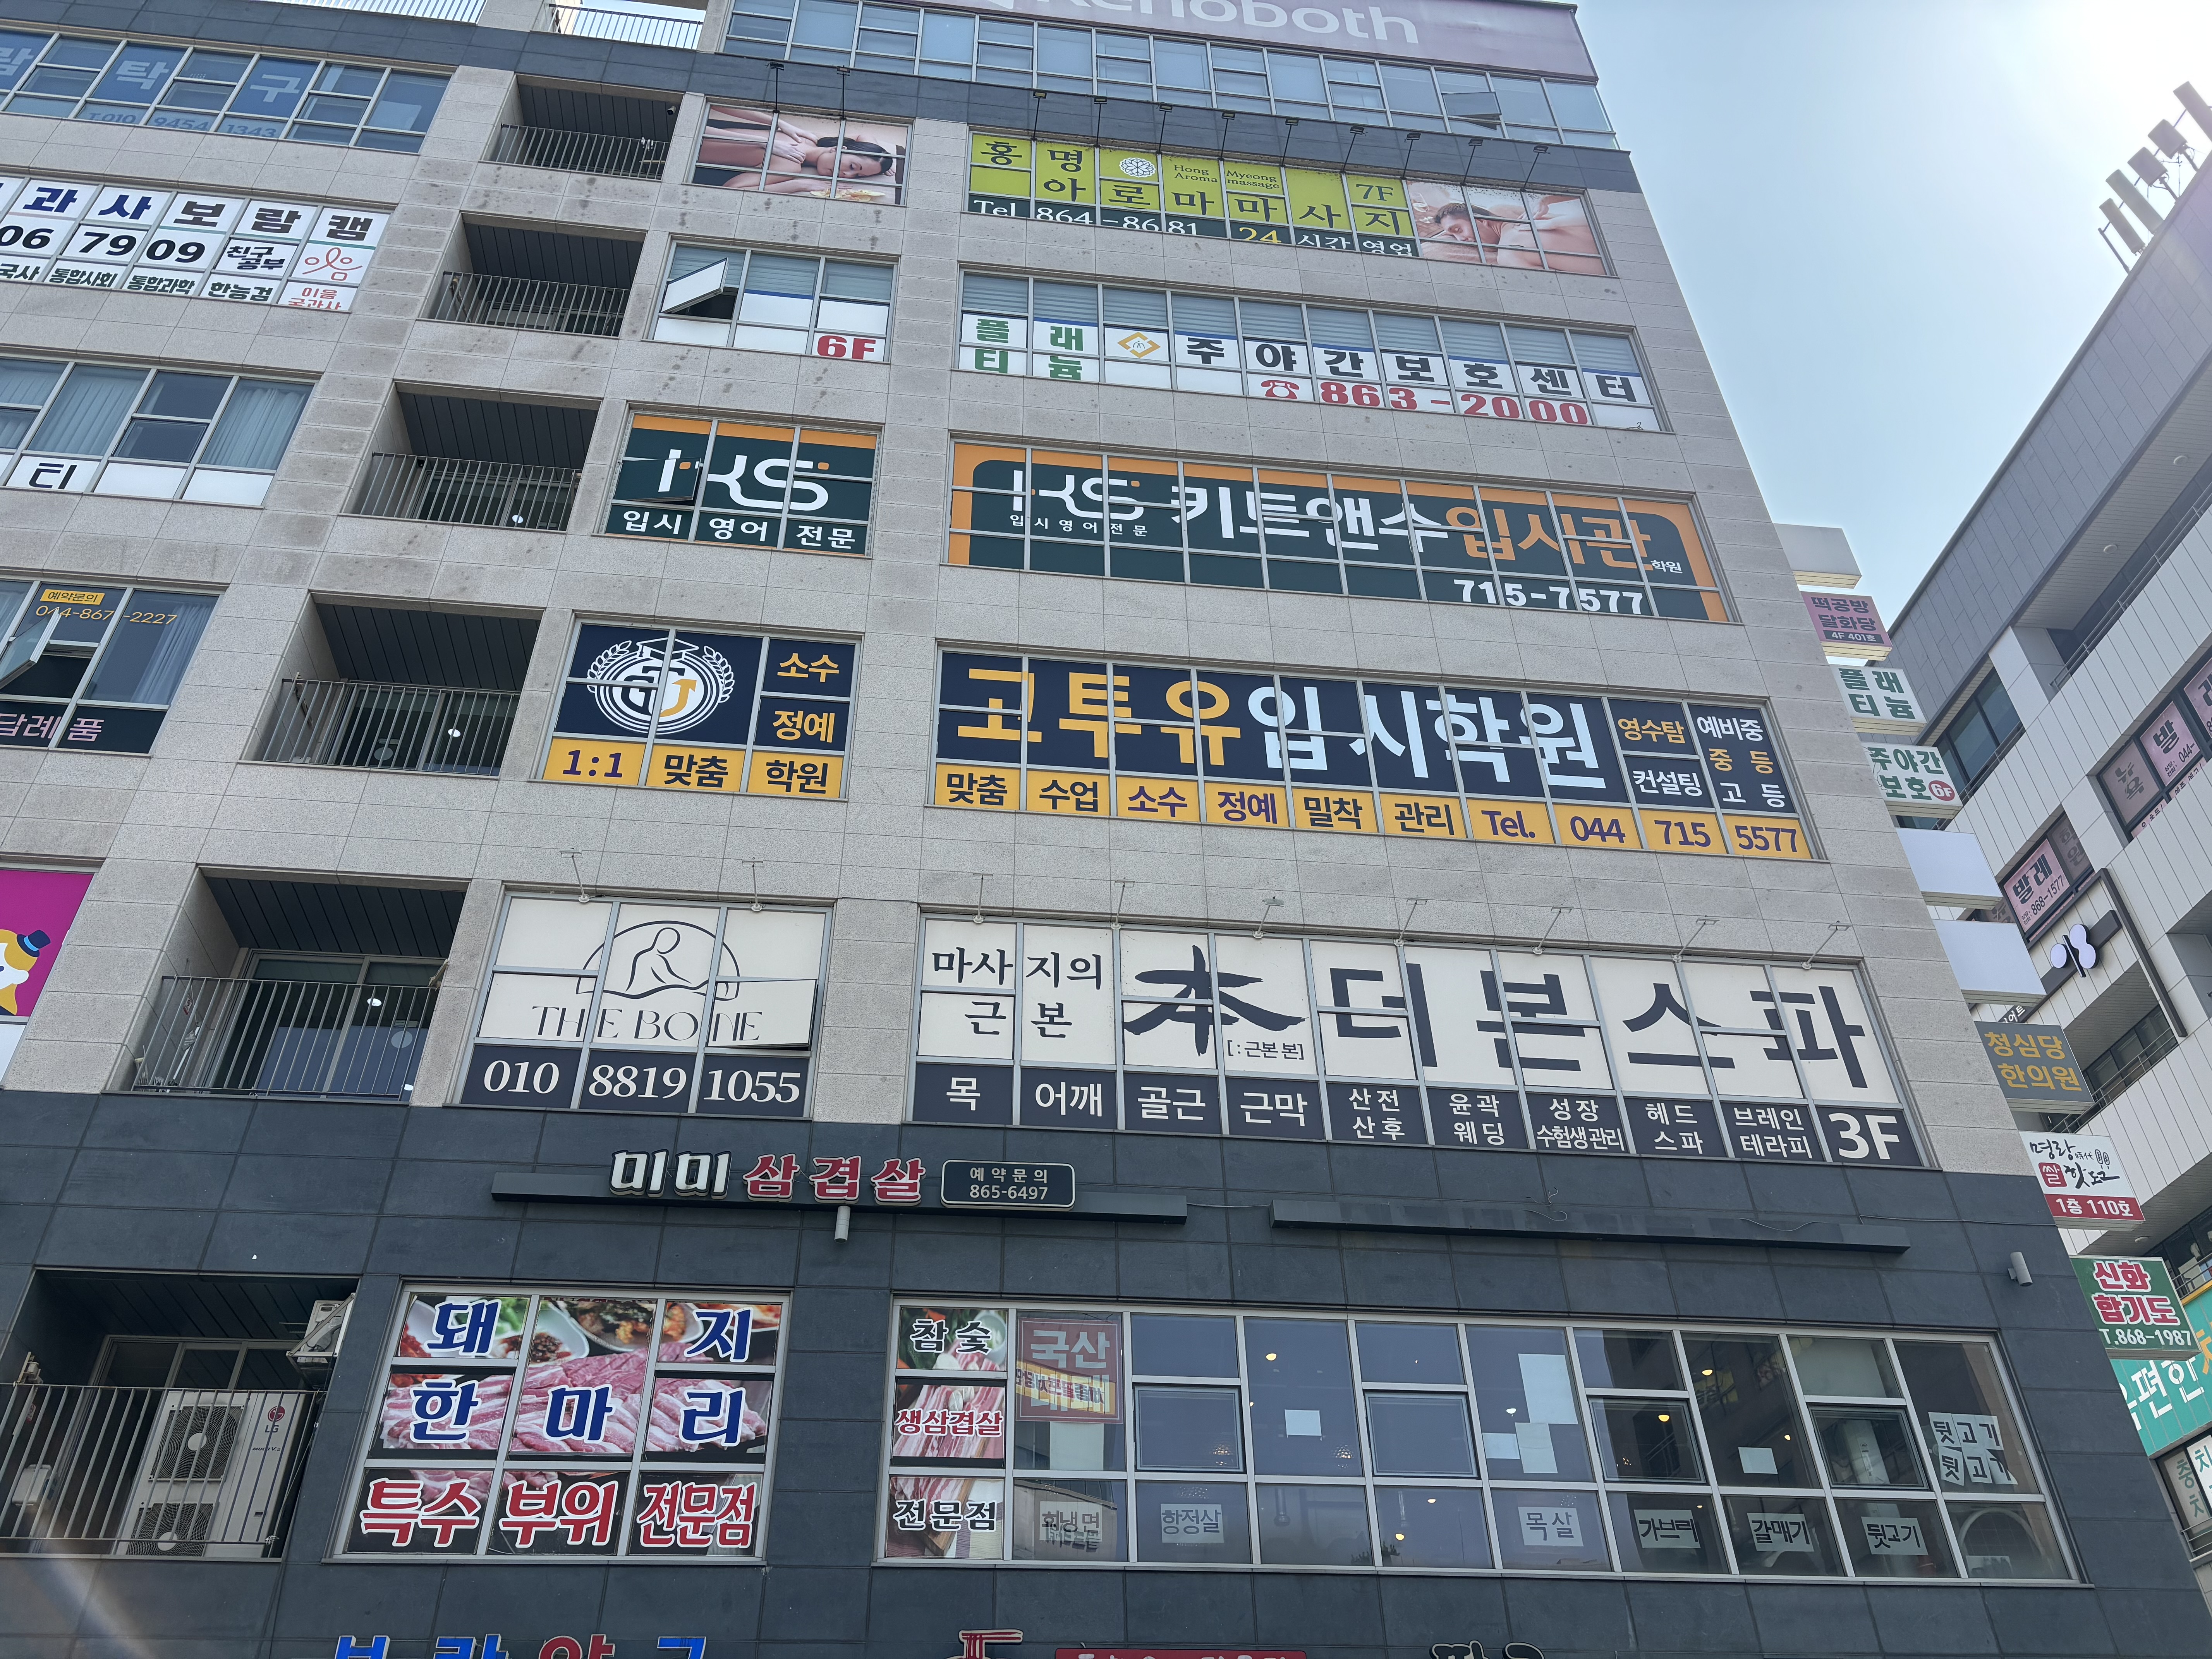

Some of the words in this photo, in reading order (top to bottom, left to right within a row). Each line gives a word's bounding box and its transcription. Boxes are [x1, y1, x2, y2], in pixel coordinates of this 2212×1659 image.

[1071, 0, 1418, 44] hoboth
[1174, 165, 1209, 175] Hong
[1226, 170, 1277, 183] Myeong
[1356, 183, 1393, 201] 7F
[1175, 172, 1218, 183] Aroma
[1227, 179, 1280, 189] massage
[0, 183, 152, 220] 과사
[973, 200, 1016, 216] Tel
[227, 246, 274, 258] 친구
[237, 258, 285, 270] 공부
[49, 268, 118, 288] 통합사회
[127, 275, 195, 295] 통합과학
[208, 282, 273, 302] 한능검
[302, 287, 337, 299] 이음
[817, 335, 876, 360] 6F
[623, 510, 682, 535] 입시
[709, 517, 768, 542] 영어
[796, 524, 855, 550] 전문
[1650, 560, 1683, 574] 학원
[48, 591, 98, 603] 예약문의
[1453, 579, 1643, 615] 715-7577
[1811, 597, 1868, 614] 떡공방
[1819, 614, 1877, 631] 달화당
[1831, 632, 1845, 640] 4F
[1848, 632, 1877, 642] 401호
[777, 653, 840, 683] 소수
[773, 711, 836, 743] 정예
[1247, 686, 1607, 788] 입시학원
[1618, 718, 1686, 744] 영수탐
[1697, 716, 1764, 742] 예비중
[562, 750, 623, 777] 1:1
[663, 754, 728, 788] 맞춤
[766, 760, 829, 794] 학원
[1867, 747, 1944, 775] 주야간
[1632, 770, 1703, 797] 컨설팅
[1879, 775, 1932, 800] 보호
[1930, 783, 1953, 798] 6F
[946, 773, 1008, 805] 맞춤
[1039, 780, 1099, 812] 수업
[1127, 786, 1187, 817] 소수
[1217, 791, 1278, 824] 정예
[1304, 796, 1363, 830] 밀착
[1395, 802, 1455, 835] 관리
[1481, 810, 1536, 838] Tel.
[1570, 815, 1626, 843] 044
[1654, 820, 1711, 847] 715
[1735, 824, 1798, 852] 5577
[2012, 854, 2053, 905] 발레
[2031, 874, 2064, 915] 868-1577
[532, 1006, 623, 1039] THE
[634, 1010, 763, 1042] BONE
[1984, 1032, 2066, 1060] 청심당
[484, 1060, 560, 1094] 010
[588, 1065, 687, 1099] 8819
[703, 1069, 801, 1103] 1055
[1997, 1063, 2083, 1091] 한의원
[946, 1077, 981, 1111] 목
[1035, 1082, 1103, 1118] 어깨
[1137, 1085, 1206, 1120] 골근
[1240, 1091, 1308, 1127] 근막
[1349, 1088, 1400, 1113] 산전
[1449, 1093, 1500, 1118] 윤곽
[1549, 1098, 1599, 1123] 성장
[1645, 1103, 1698, 1125] 헤드
[1733, 1107, 1805, 1131] 브레인
[1352, 1116, 1405, 1141] 산후
[1453, 1121, 1505, 1146] 웨딩
[1828, 1113, 1901, 1160] 3F
[1654, 1131, 1704, 1155] 스파
[1739, 1134, 1813, 1159] 테라피
[2029, 1139, 2076, 1161] 명랑
[610, 1148, 732, 1197] 미미
[742, 1153, 927, 1206] 삼겹살
[2063, 1161, 2121, 1189] 핫도그
[969, 1184, 1048, 1200] 865-6497
[2056, 1198, 2083, 1214] 1층
[2086, 1199, 2134, 1216] 110호
[2093, 1260, 2152, 1292] 신화
[2091, 1292, 2181, 1326] 합기도
[1030, 1329, 1110, 1369] 국산
[2099, 1328, 2192, 1346] T.868-1987
[264, 1424, 279, 1433] LG
[894, 1409, 1004, 1438] 생삼겹살
[1933, 1421, 2001, 1446] 뒷고기
[1941, 1455, 2011, 1481] 뒷고기
[360, 1477, 482, 1547] 특수
[499, 1479, 620, 1549] 부위
[637, 1480, 758, 1549] 전문점
[892, 1498, 998, 1533] 전문점
[1161, 1509, 1222, 1535] 항정살
[1526, 1511, 1575, 1541] 목살
[1638, 1518, 1698, 1542] 가브리
[1752, 1520, 1810, 1545] 갈매기
[1865, 1523, 1921, 1548] 뒷고기
